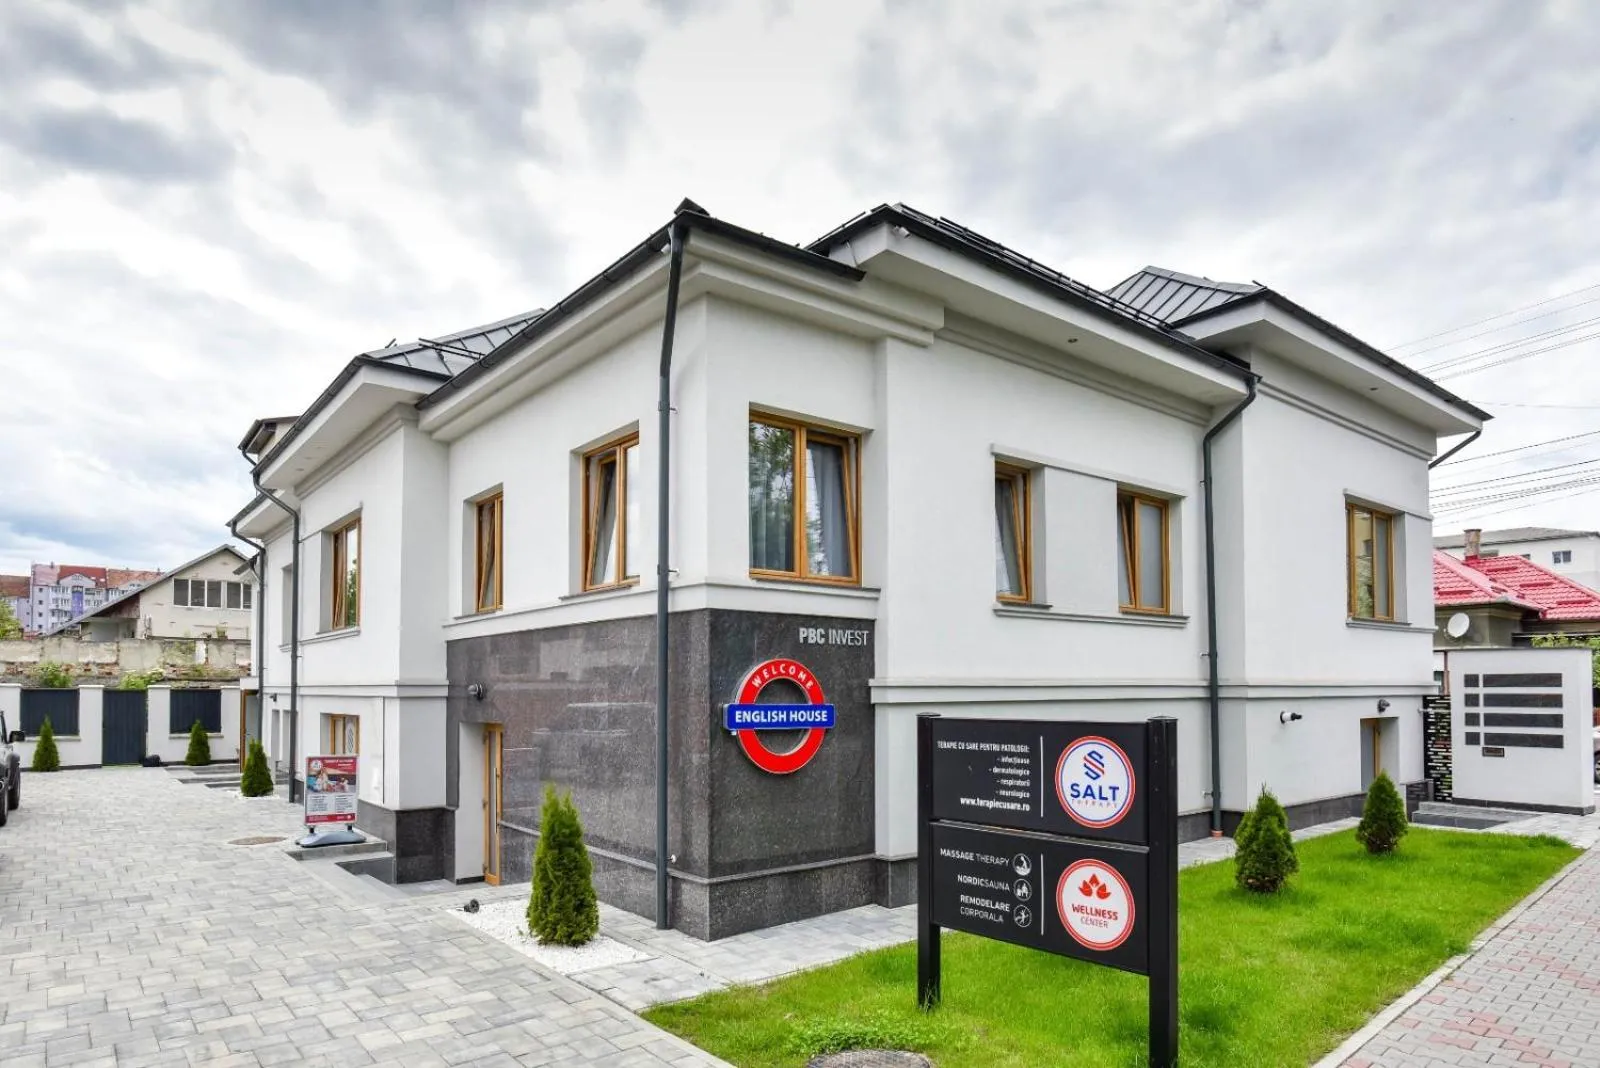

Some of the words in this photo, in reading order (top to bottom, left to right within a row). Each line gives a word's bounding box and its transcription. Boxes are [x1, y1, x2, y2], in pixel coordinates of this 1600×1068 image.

[800, 628, 826, 644] PBC
[829, 630, 869, 646] INVEST
[752, 663, 813, 689] WELCOME
[735, 710, 787, 723] ENGLISH
[789, 710, 828, 722] HOUSE
[1070, 783, 1119, 801] SALT
[960, 798, 1030, 811] www.terapiecusare.ro
[940, 848, 975, 860] MASSAGE
[976, 853, 1009, 866] THERAPY
[960, 894, 1010, 912] REMODELARE
[960, 906, 1004, 923] CORPORALA
[1072, 904, 1118, 920] WELLNESS
[1080, 916, 1109, 928] CENTER
